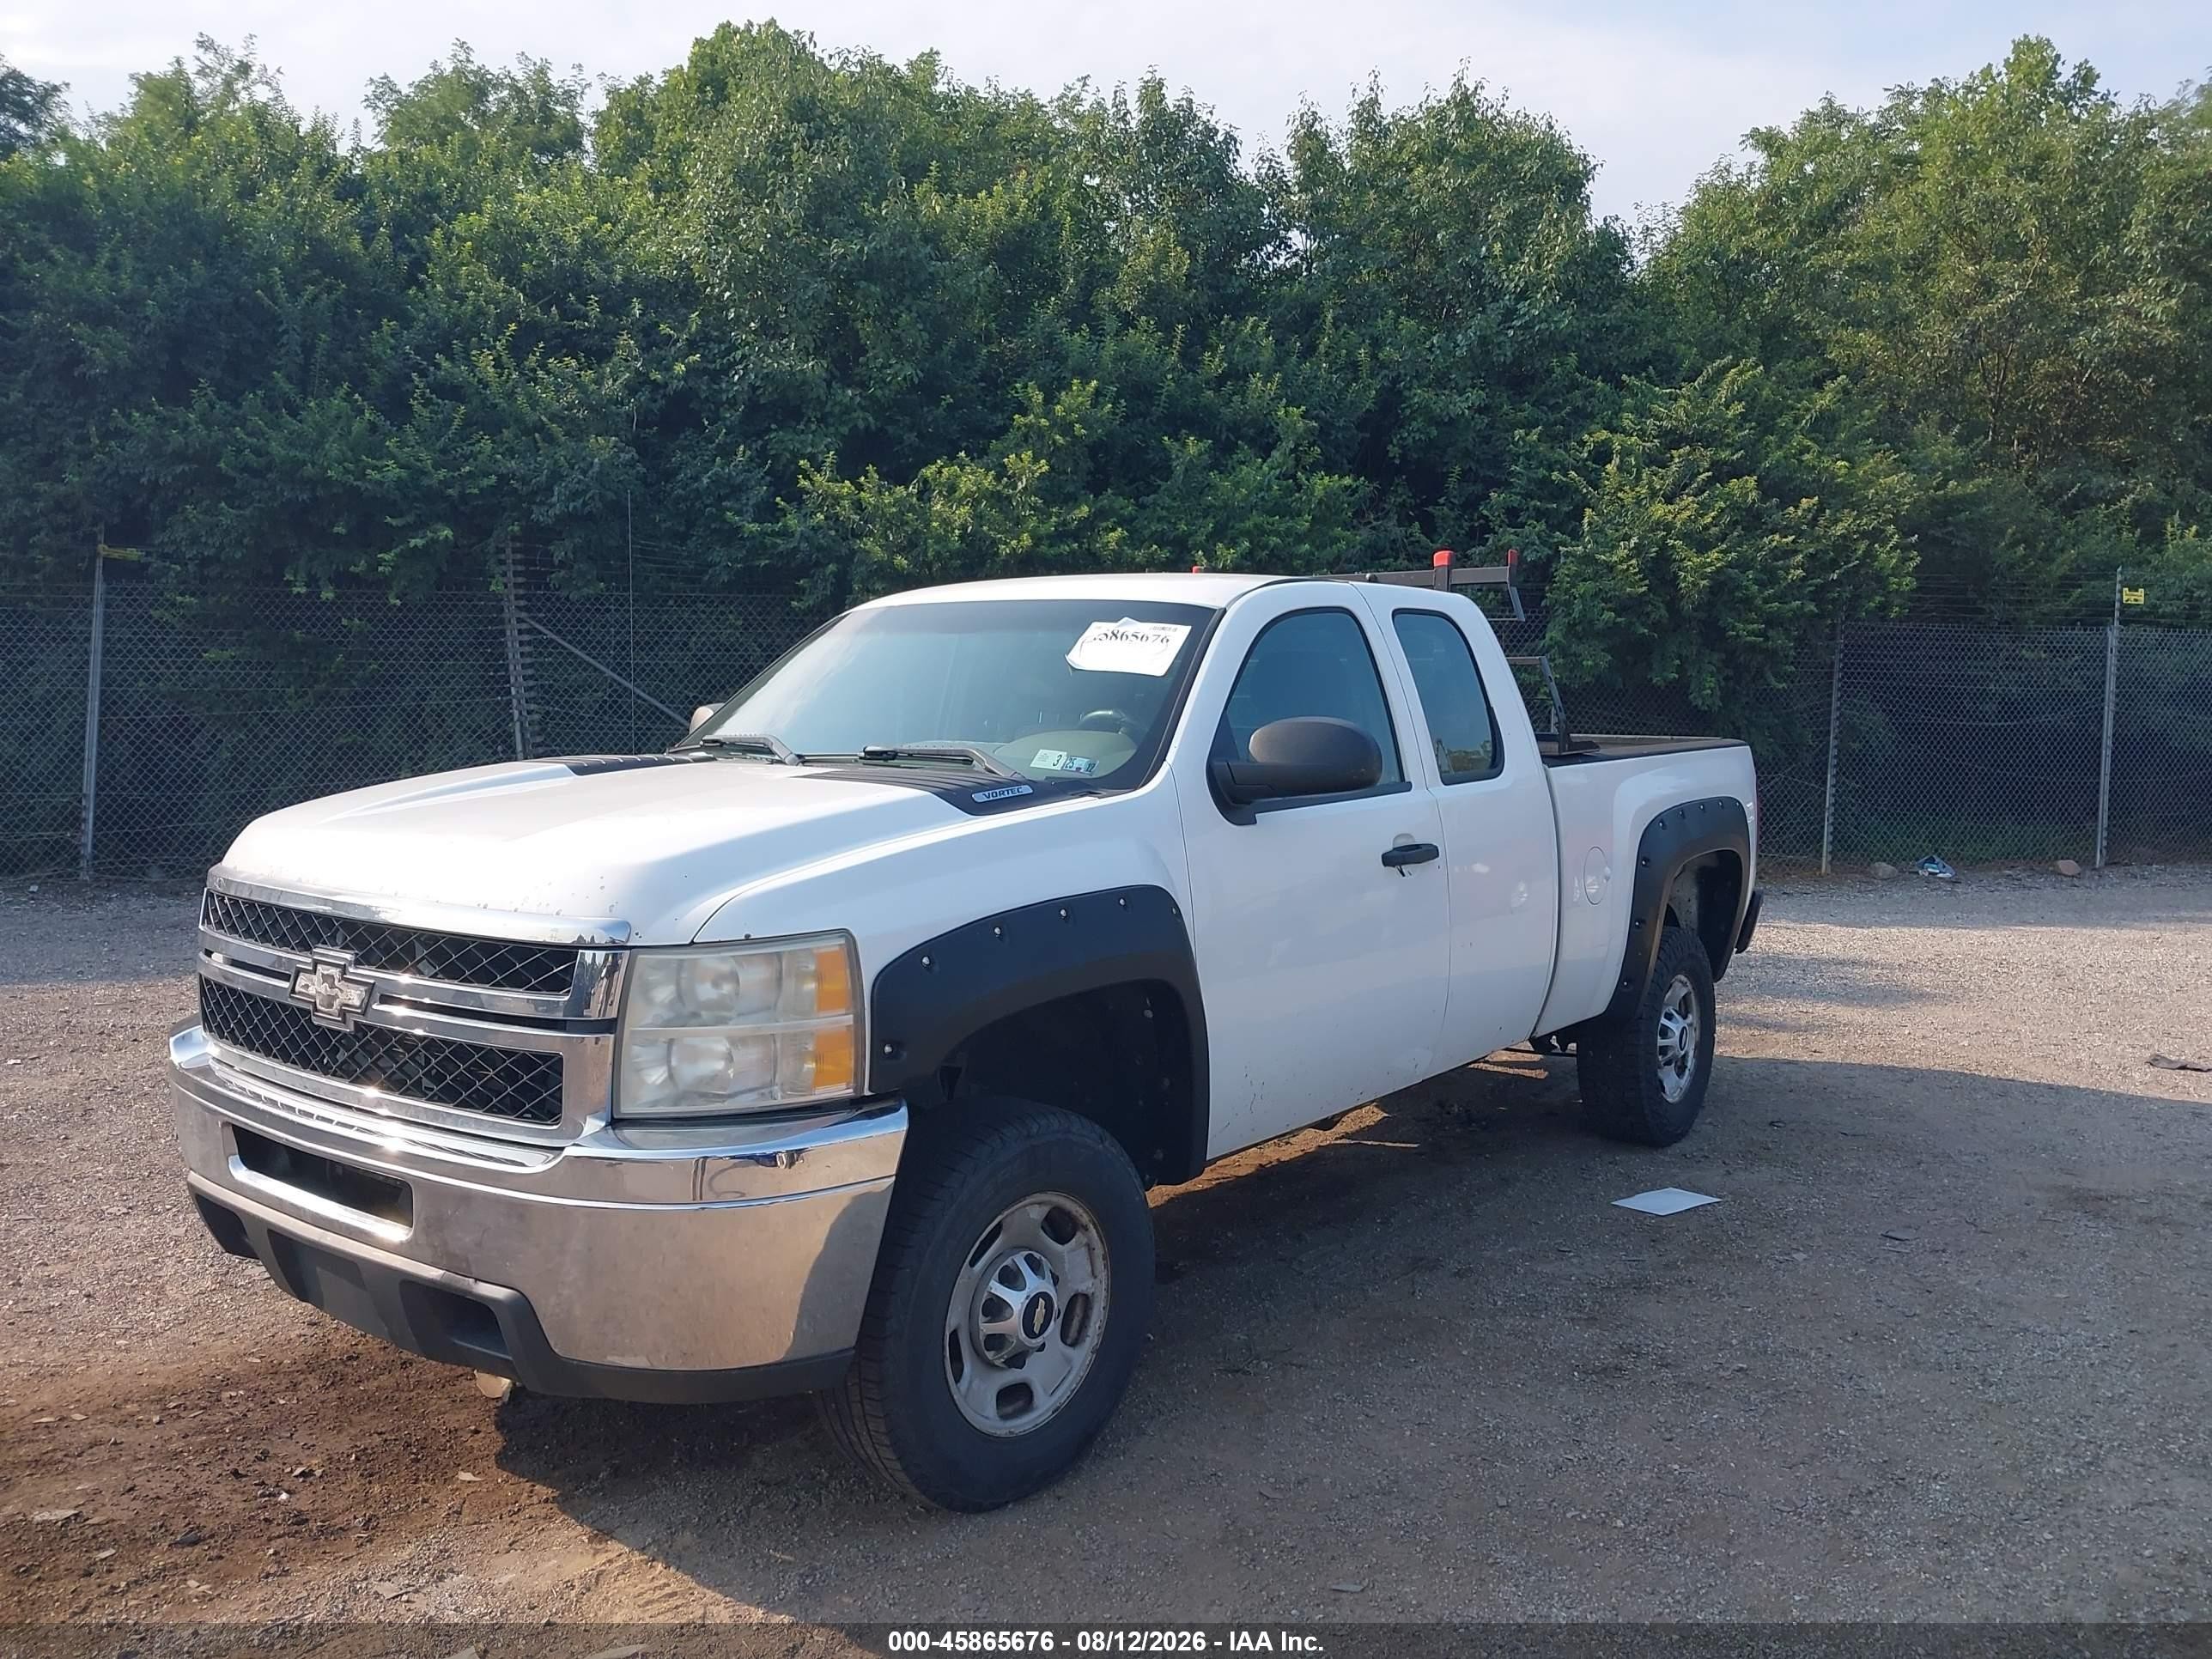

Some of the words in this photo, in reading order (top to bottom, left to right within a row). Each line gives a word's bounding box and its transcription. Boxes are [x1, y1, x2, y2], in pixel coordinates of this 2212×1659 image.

[1052, 754, 1063, 767] 3
[1065, 757, 1076, 769] 25
[982, 787, 1024, 799] VORTEC
